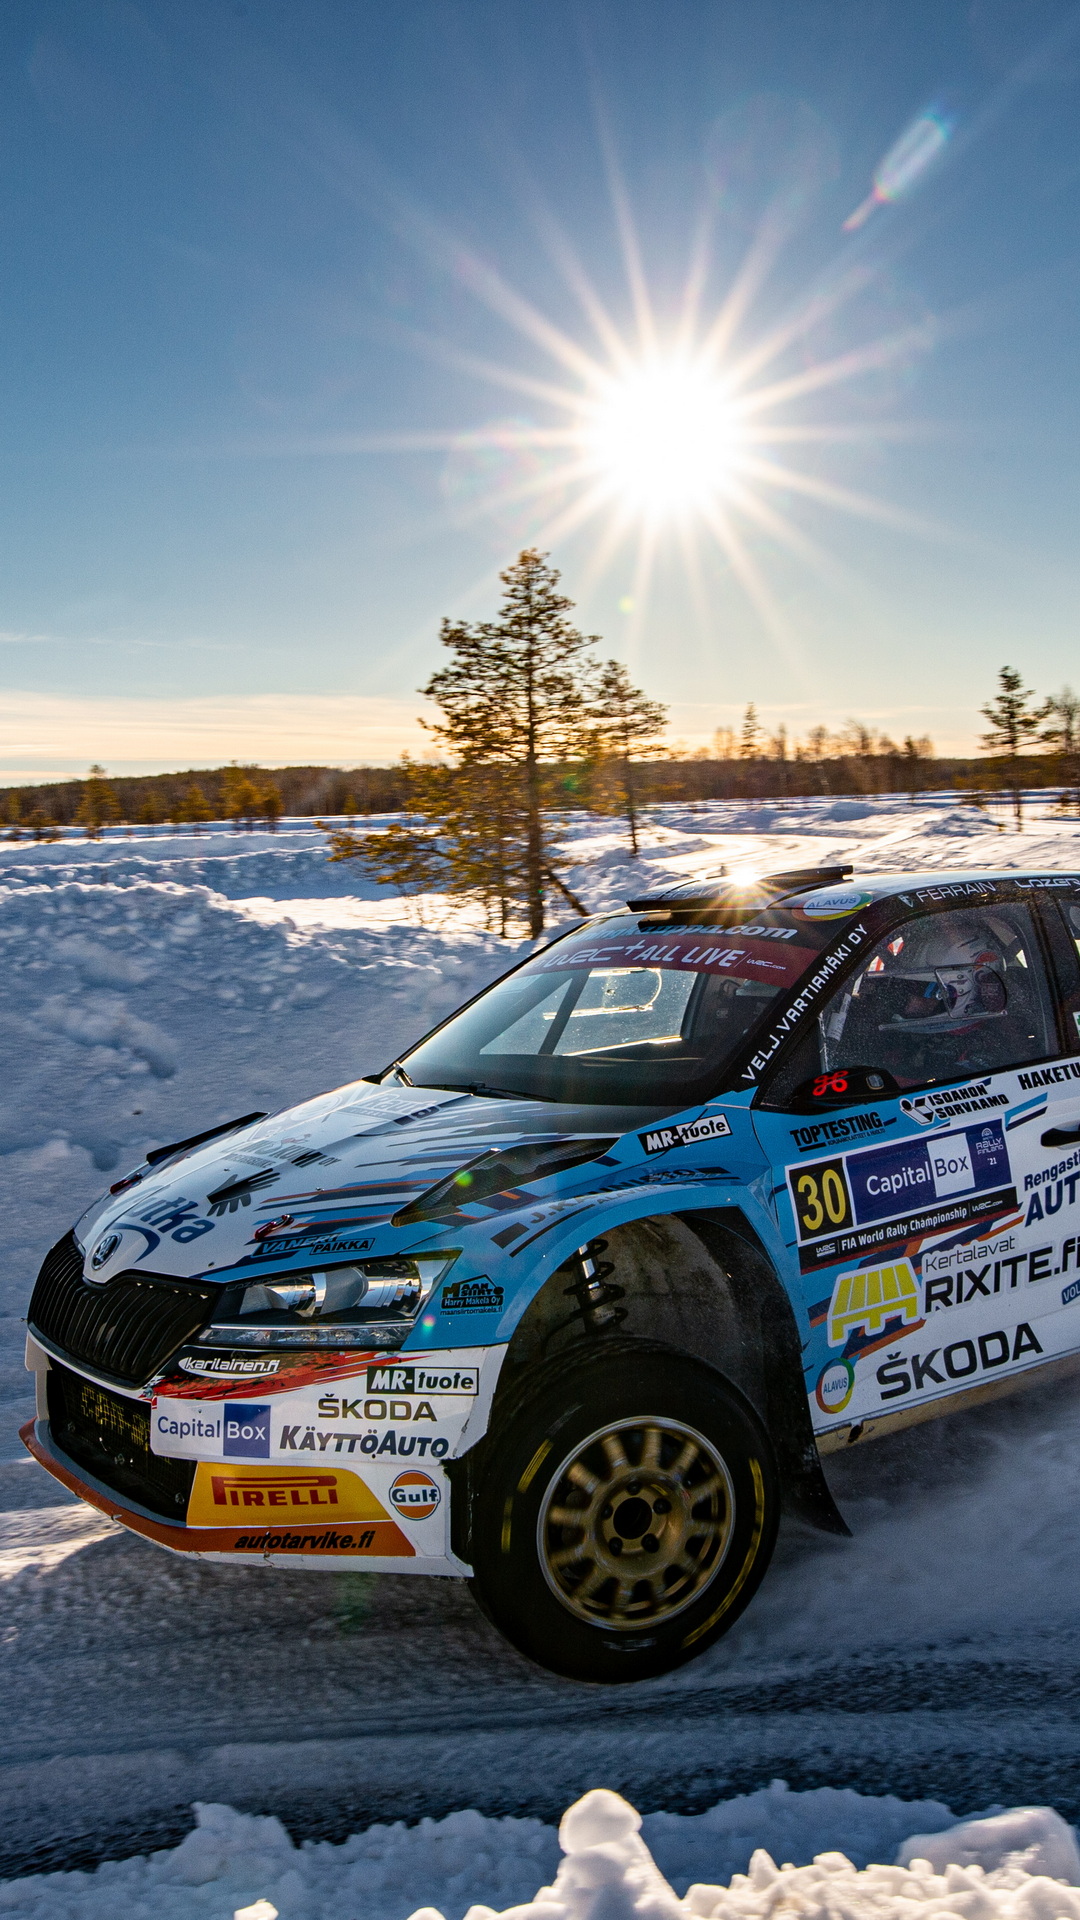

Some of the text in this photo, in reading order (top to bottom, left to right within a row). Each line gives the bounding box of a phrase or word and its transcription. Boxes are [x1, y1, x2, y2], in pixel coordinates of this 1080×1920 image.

[807, 896, 858, 909] ALAVUS
[916, 881, 997, 902] FERRAIN
[847, 923, 868, 945] OY
[633, 945, 681, 961] ALL
[681, 946, 746, 967] LIVE
[934, 1094, 1010, 1119] SORVAAMO
[646, 1119, 727, 1152] MR-tuote
[790, 1112, 883, 1146] TOPTESTING
[866, 1155, 969, 1197] Capital Box
[596, 1184, 658, 1204] ALAVUS
[797, 1169, 846, 1231] 30
[841, 1240, 857, 1251] FIA
[858, 1231, 884, 1246] World
[886, 1223, 908, 1238] Rally
[910, 1206, 967, 1231] Championship
[313, 1240, 370, 1253] PAIKKA
[925, 1235, 1016, 1273] Kertalavat
[444, 1298, 464, 1308] Harry
[490, 1296, 501, 1306] Oy
[184, 1356, 281, 1373] karilainen.fi
[876, 1322, 1044, 1400] ŠKODA
[370, 1369, 474, 1391] MR-tuote
[823, 1376, 848, 1394] ALAVUS
[317, 1394, 437, 1422] ŠKODA
[158, 1416, 266, 1441] Capital Box
[211, 1475, 339, 1506] PIRELLI
[391, 1488, 438, 1504] Gulf
[234, 1530, 376, 1549] autotarvike.fi
